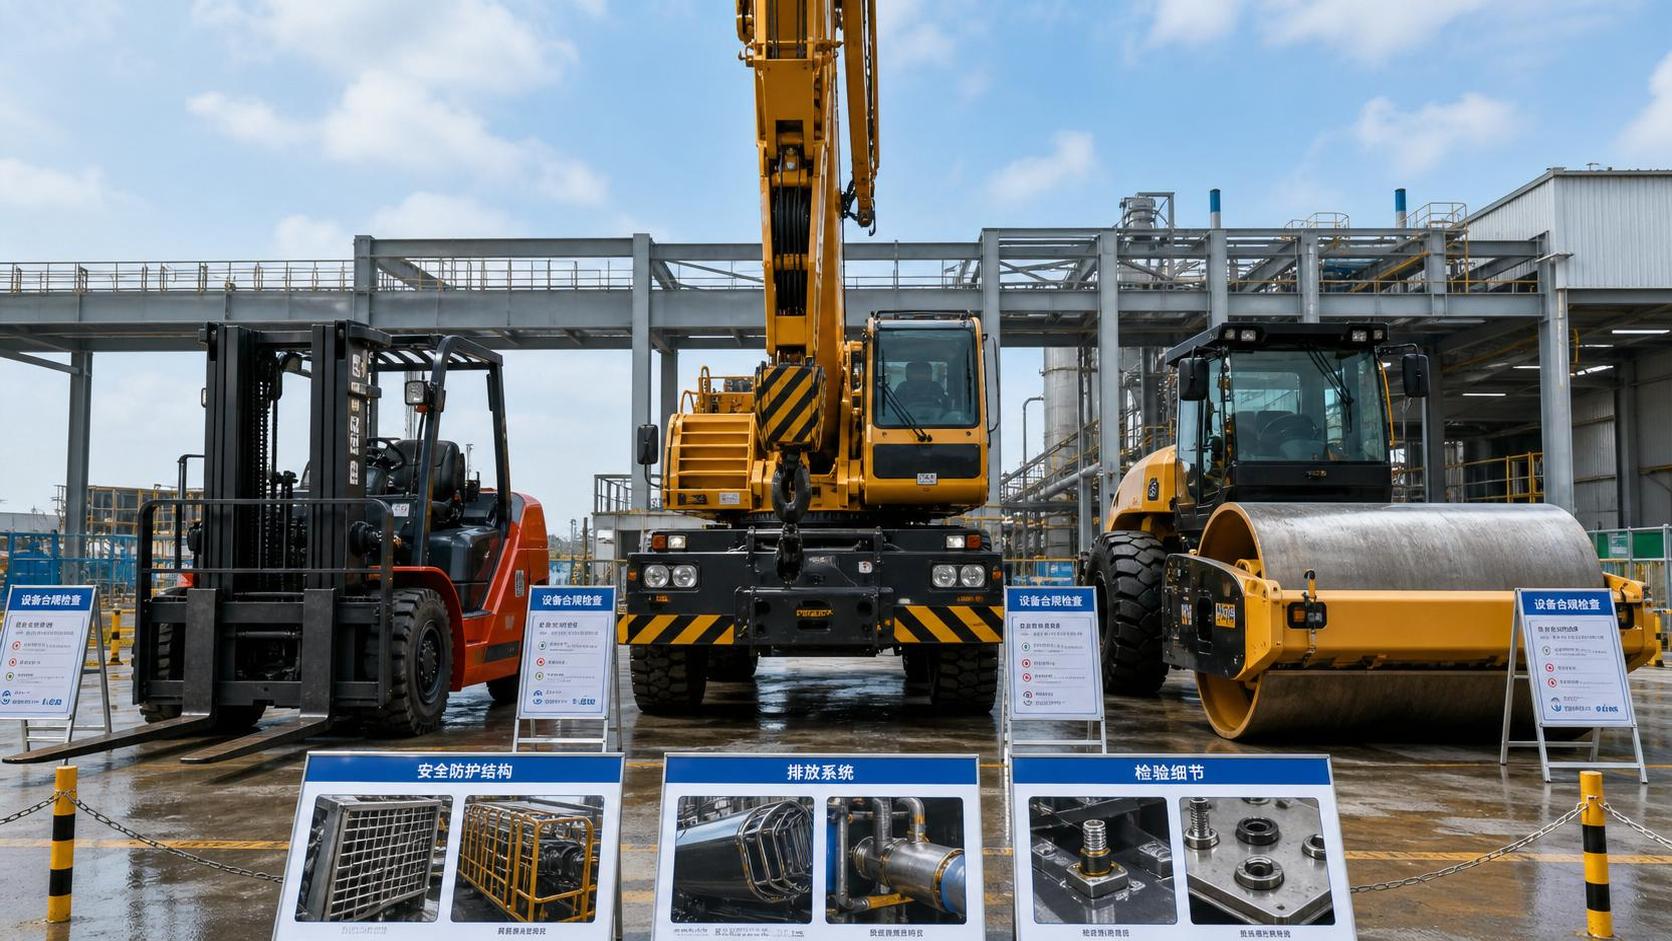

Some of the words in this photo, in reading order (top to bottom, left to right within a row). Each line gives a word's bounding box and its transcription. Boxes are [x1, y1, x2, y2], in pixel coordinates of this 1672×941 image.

[417, 763, 513, 780] 安全防护结构
[786, 764, 855, 781] 排放系统
[1134, 764, 1205, 781] 检验细节
